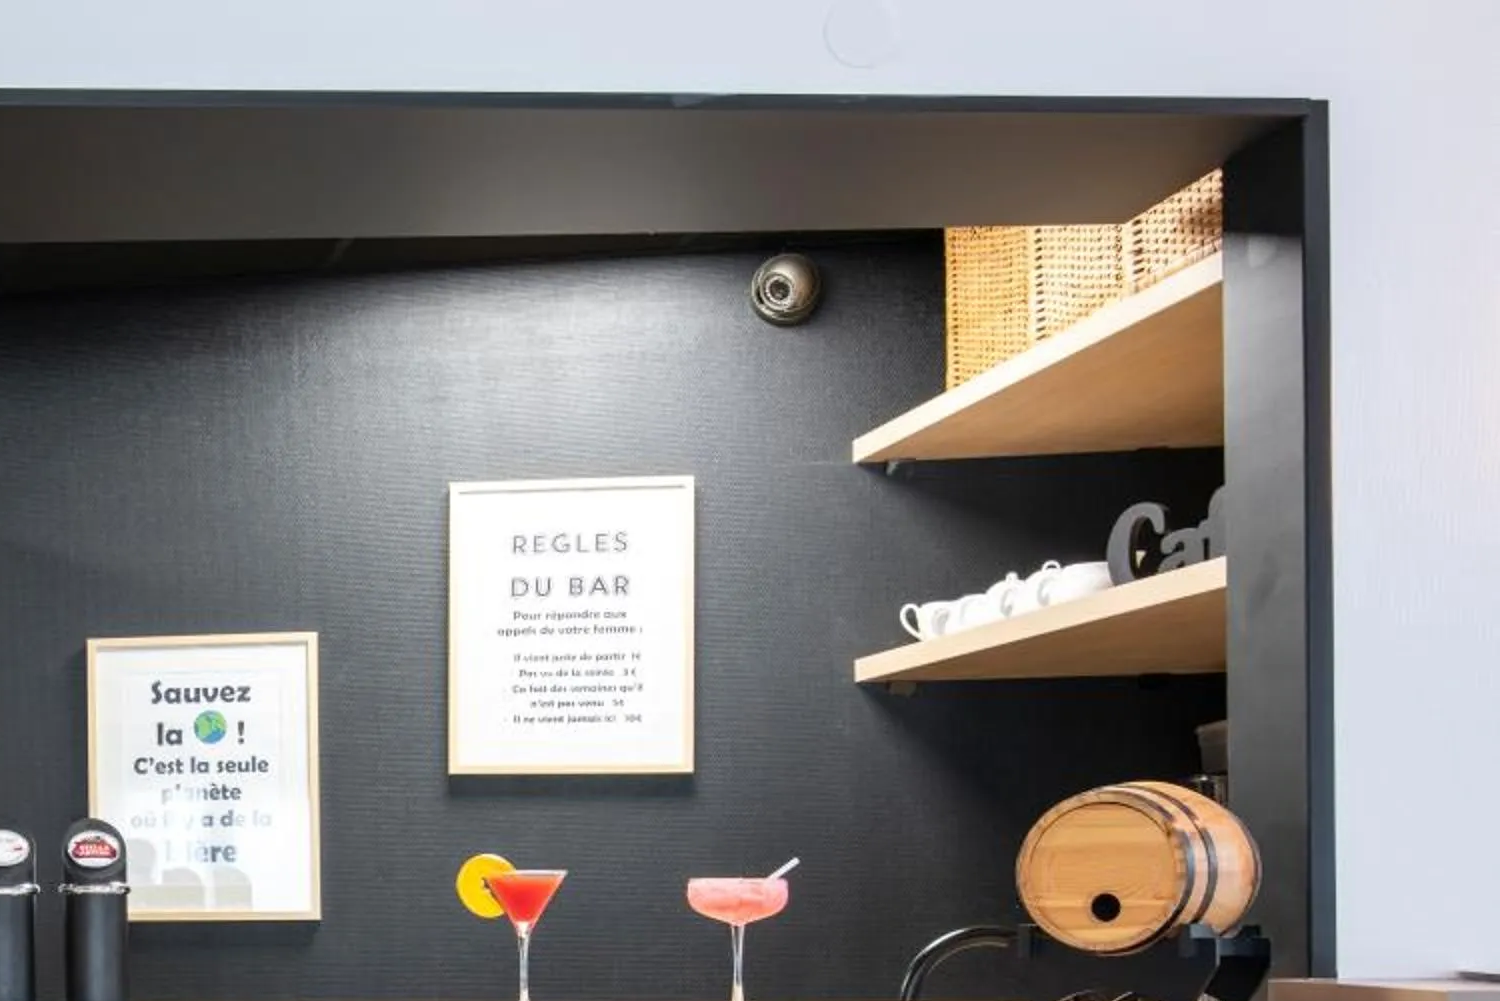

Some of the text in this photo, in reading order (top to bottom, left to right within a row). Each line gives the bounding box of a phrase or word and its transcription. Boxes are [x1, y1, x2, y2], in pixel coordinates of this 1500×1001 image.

[512, 531, 628, 554] REGLES
[510, 575, 630, 597] DU BAR
[513, 609, 627, 621] Pour répondre aux
[497, 625, 536, 637] appels
[558, 625, 590, 634] votre
[593, 624, 636, 634] femme
[150, 680, 251, 705] Sauvez
[157, 720, 246, 746] la !
[133, 755, 269, 775] C'est la seule
[160, 783, 242, 805] panète
[220, 809, 246, 827] de
[253, 810, 273, 827] la
